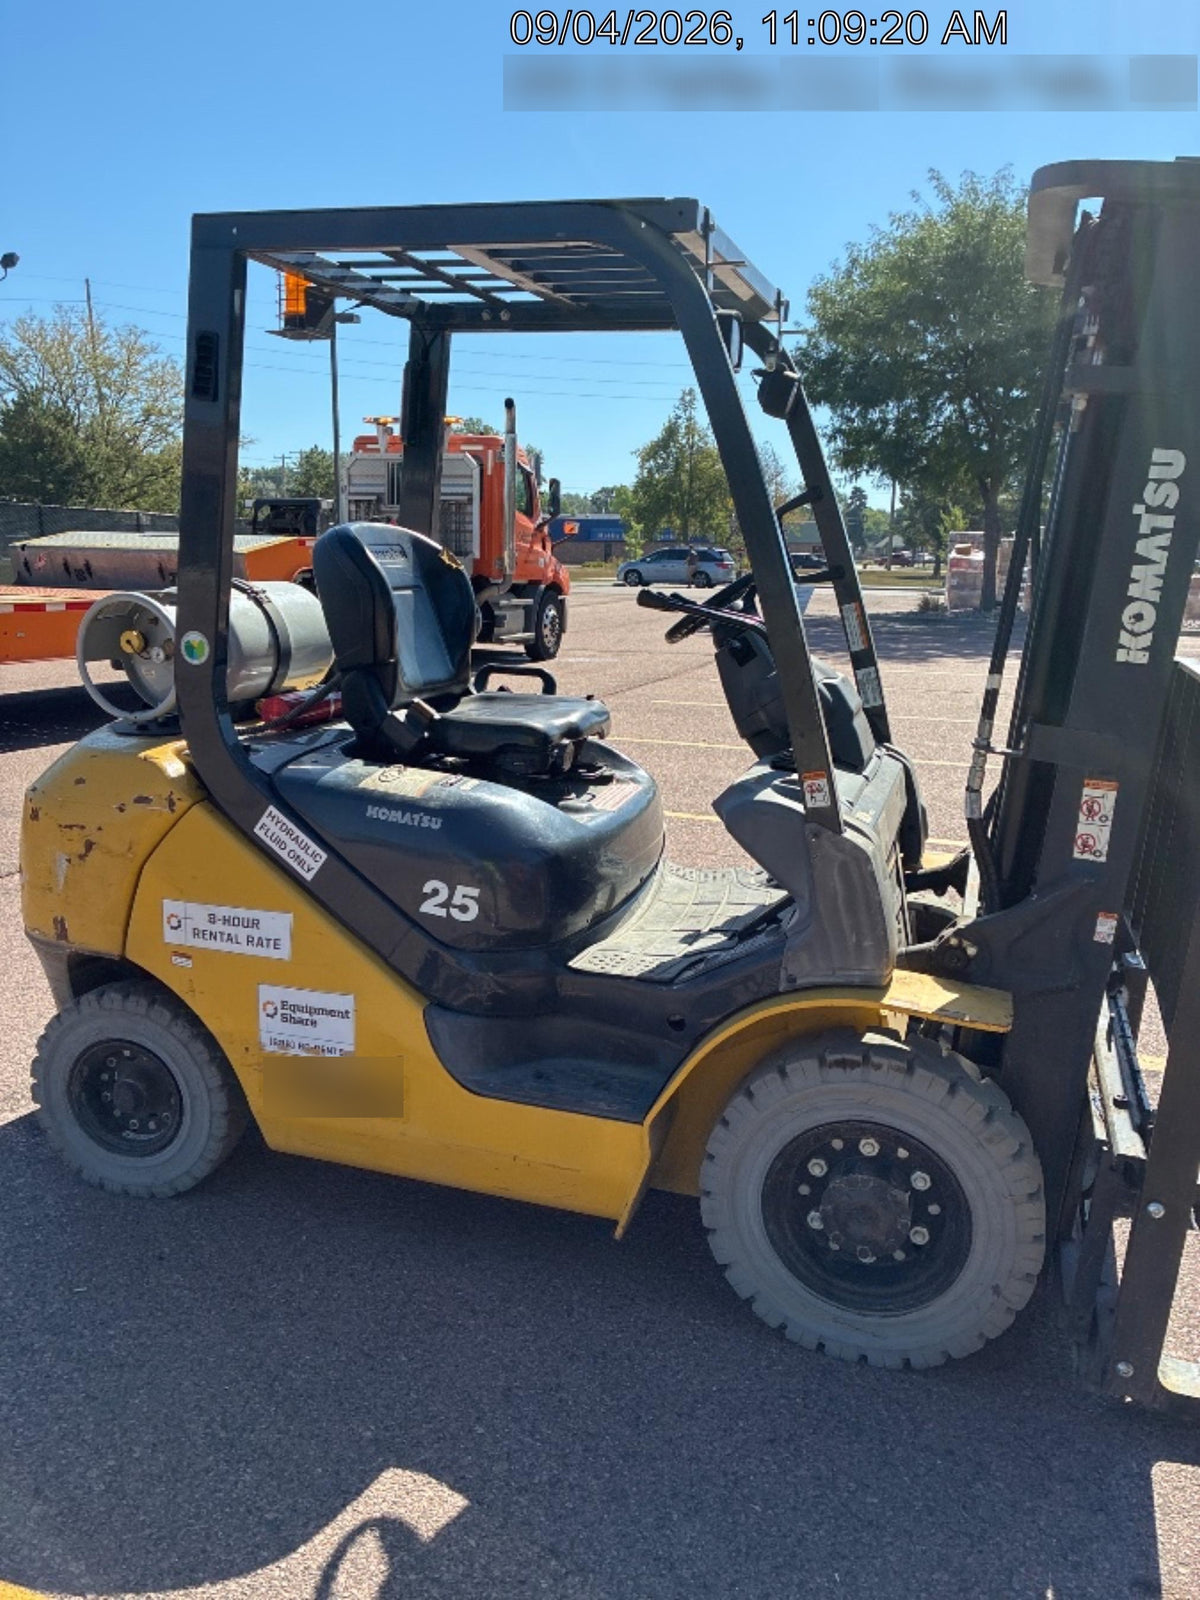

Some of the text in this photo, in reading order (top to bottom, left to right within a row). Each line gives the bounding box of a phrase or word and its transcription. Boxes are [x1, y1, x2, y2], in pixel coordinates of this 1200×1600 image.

[1116, 447, 1187, 665] KOMATSU
[366, 805, 443, 830] KOMATSU
[259, 822, 315, 874] FLUID ONLY
[266, 810, 322, 863] HYDRAULIC
[419, 879, 480, 922] 25
[208, 913, 261, 930] 8-HOUR
[192, 928, 282, 950] RENTAL RATE
[280, 1000, 351, 1019] Equipment
[280, 1013, 318, 1028] Share
